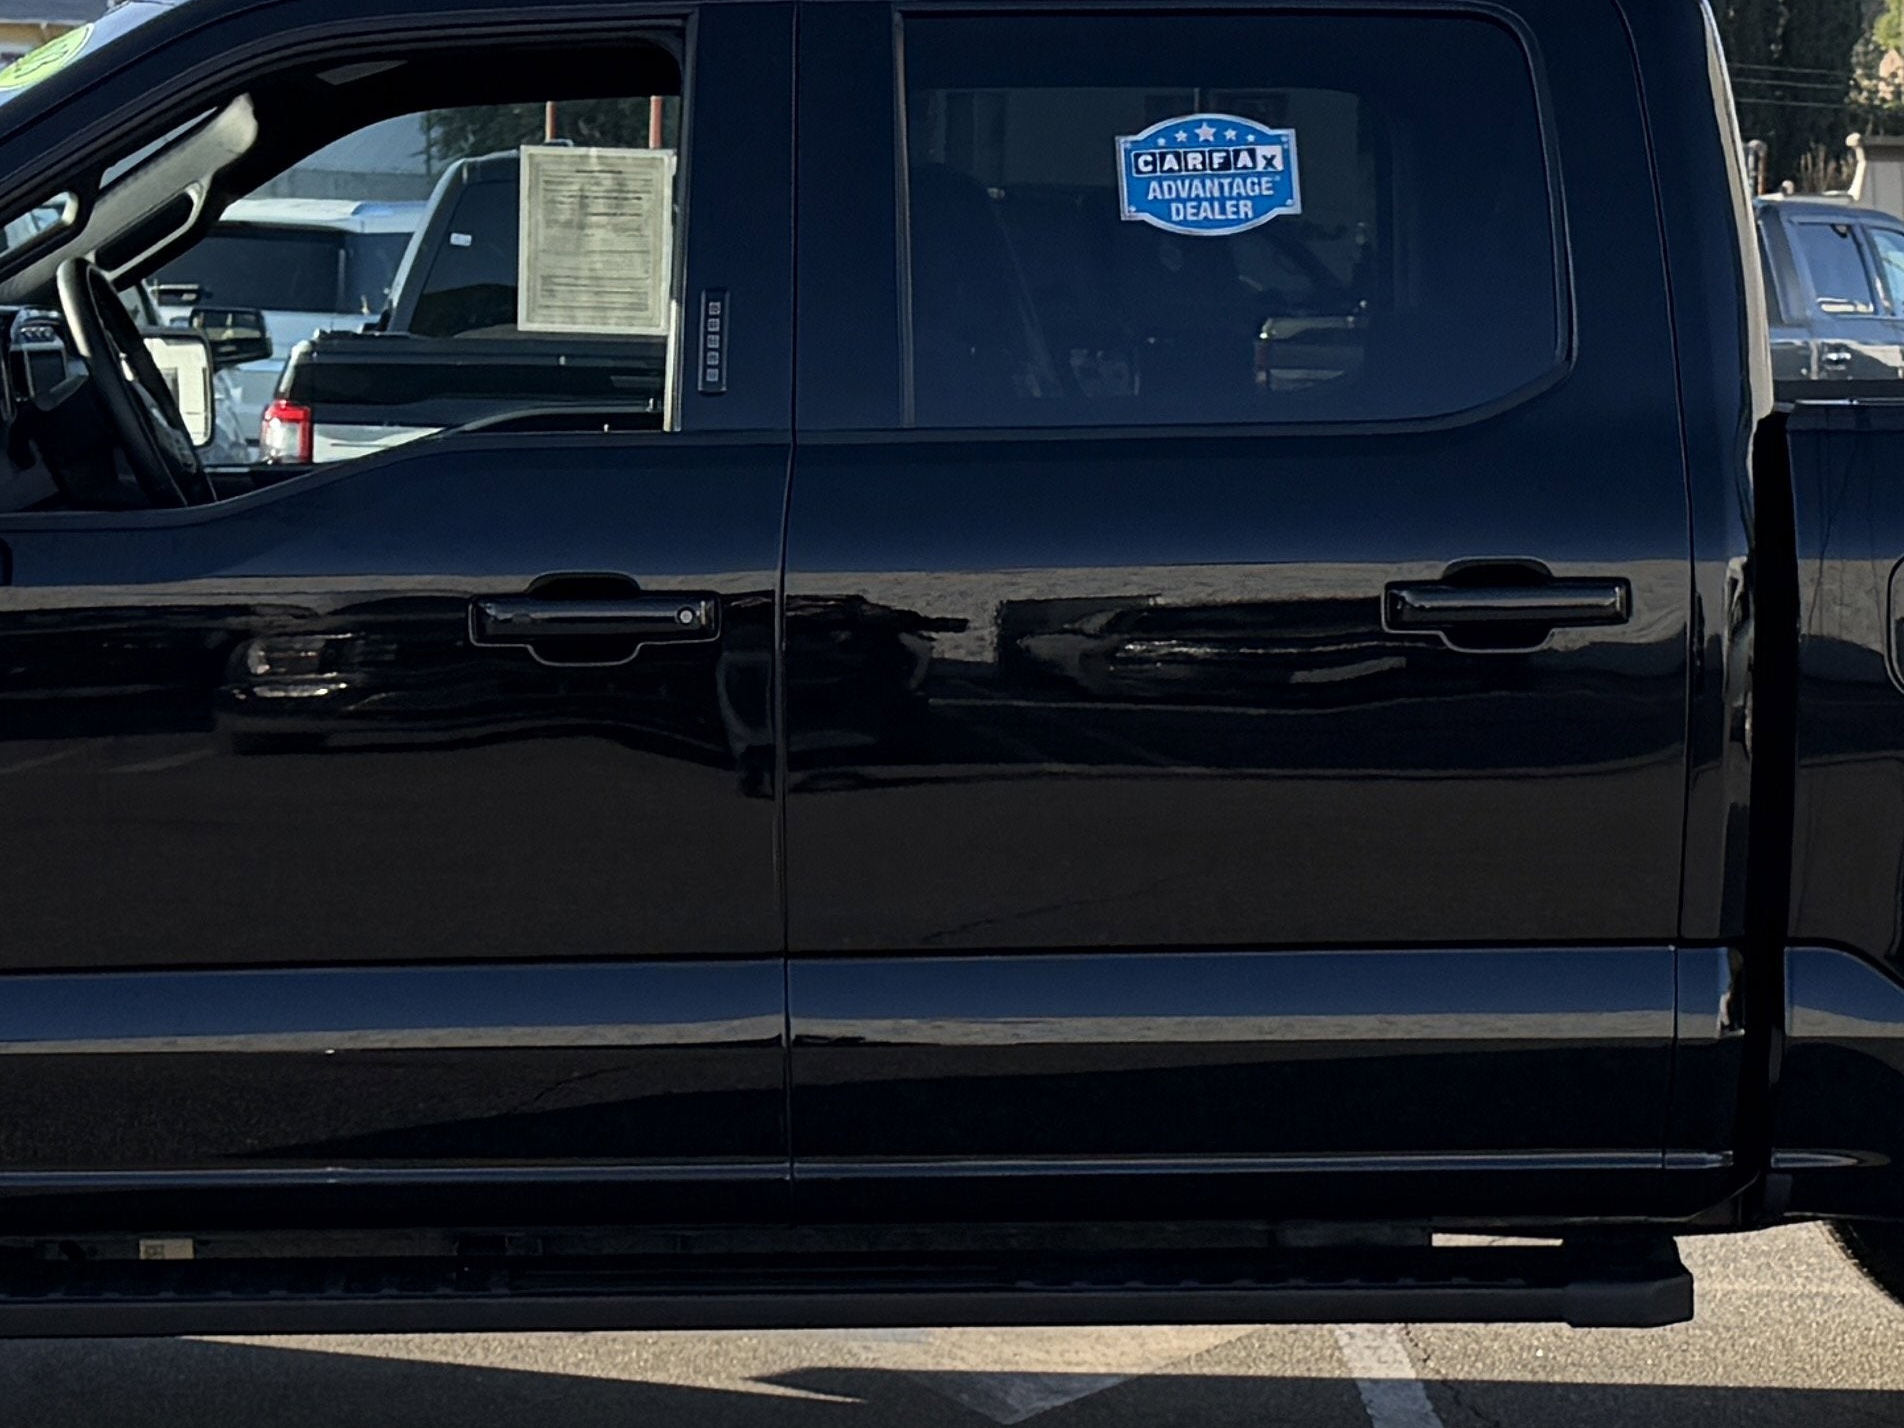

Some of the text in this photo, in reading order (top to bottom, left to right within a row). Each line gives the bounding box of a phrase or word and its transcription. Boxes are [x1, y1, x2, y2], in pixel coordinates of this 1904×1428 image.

[1134, 146, 1283, 176] CARFAX
[1147, 177, 1274, 201] ADVANTAGE
[1170, 200, 1253, 221] DEALER
